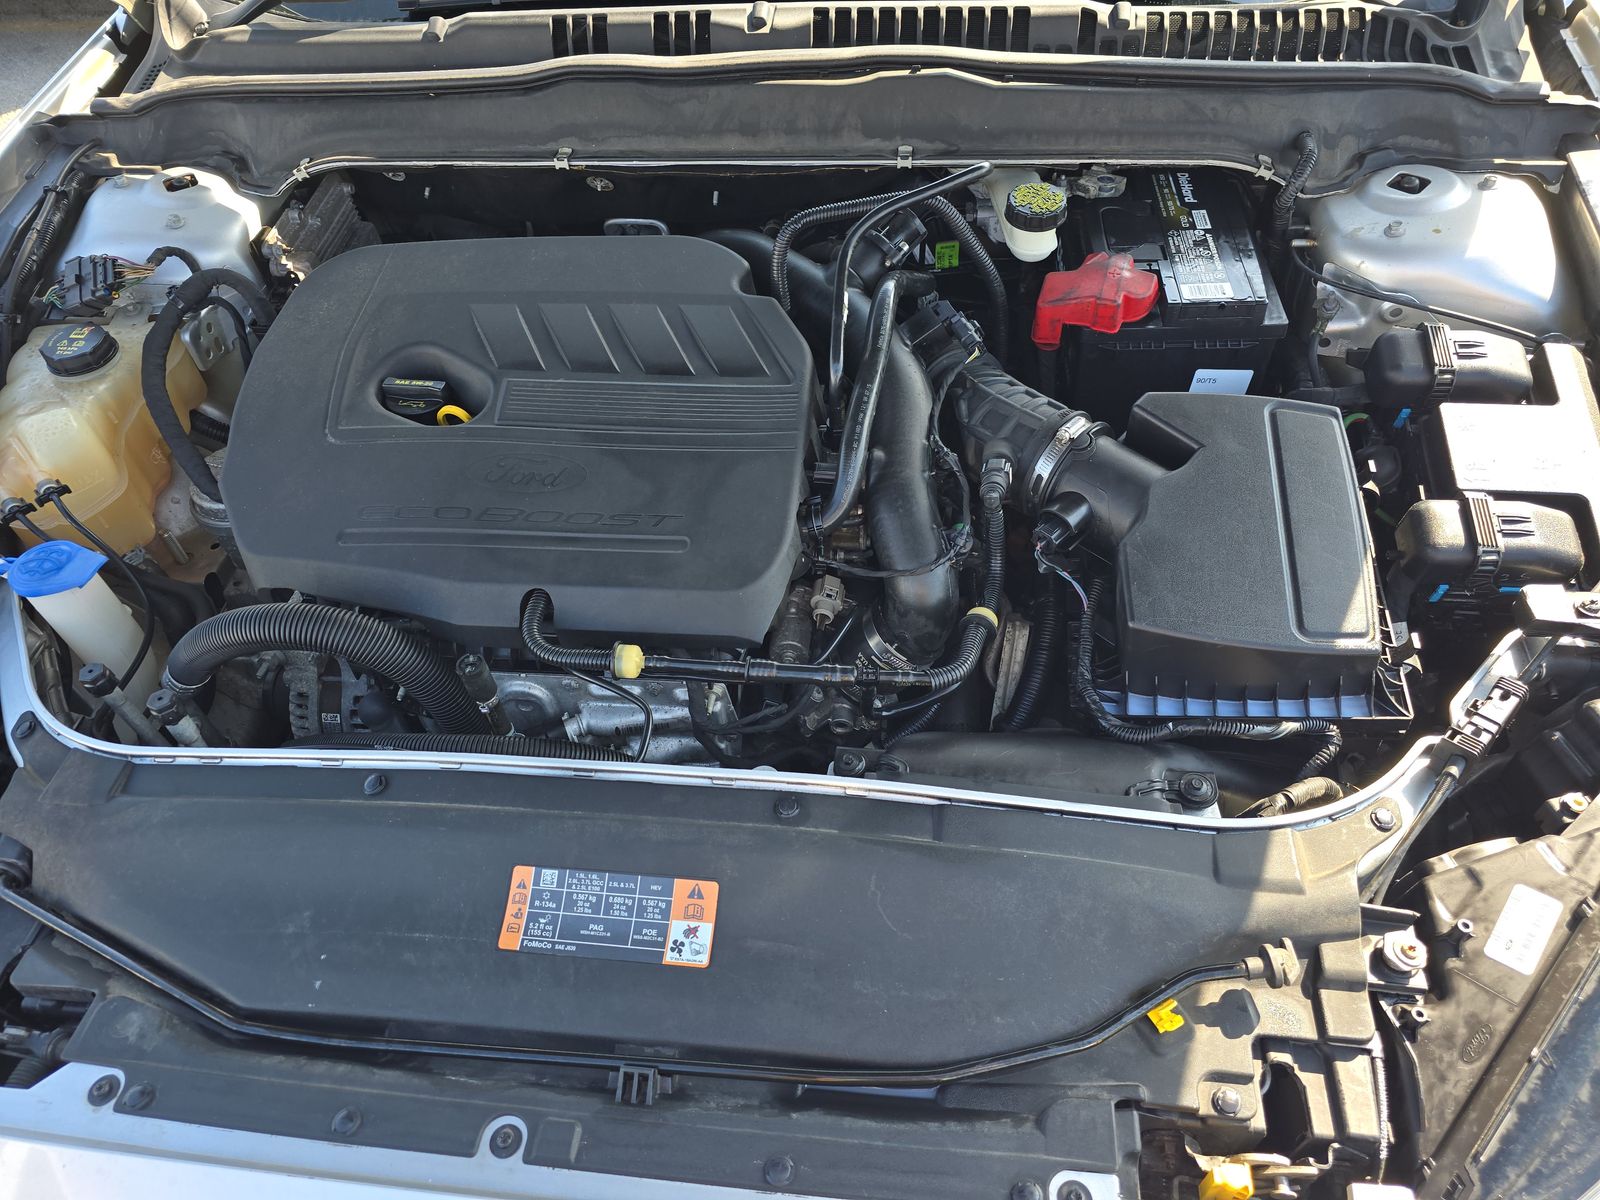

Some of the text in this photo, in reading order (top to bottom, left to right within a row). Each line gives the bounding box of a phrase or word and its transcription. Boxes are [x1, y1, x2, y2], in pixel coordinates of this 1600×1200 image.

[1176, 172, 1198, 203] DieHard
[487, 455, 569, 488] Ford
[358, 506, 686, 528] ECOBOOST
[534, 901, 556, 909] R-134a
[523, 940, 552, 949] FoMoCo
